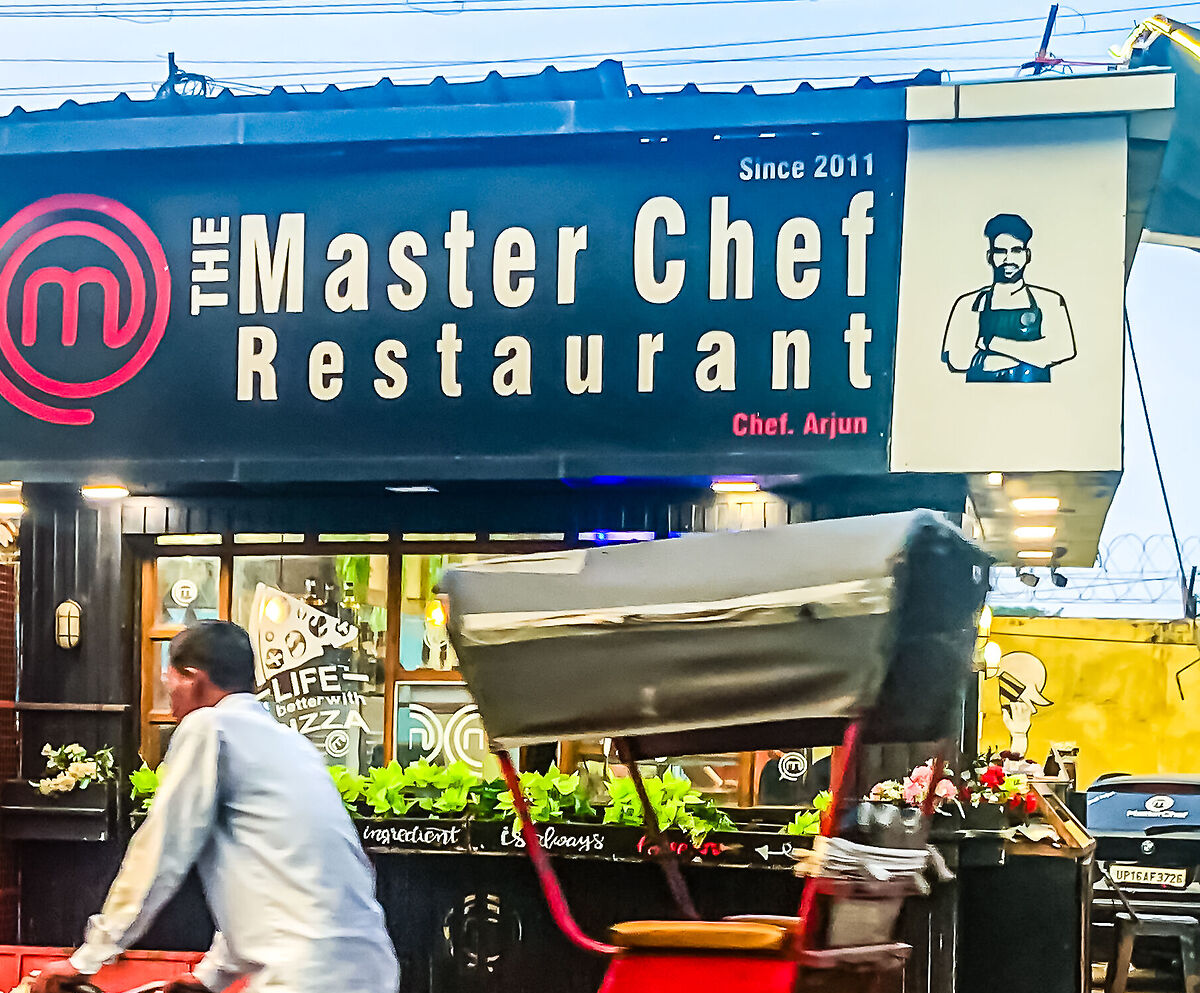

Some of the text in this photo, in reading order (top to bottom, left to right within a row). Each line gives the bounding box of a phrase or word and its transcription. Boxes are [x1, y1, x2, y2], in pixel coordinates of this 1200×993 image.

[739, 153, 873, 181] Since 2011
[190, 190, 874, 316] THE Master Chef
[236, 313, 872, 401] Restaurant
[732, 411, 868, 439] Chef. Arjun
[272, 665, 342, 703] LIFE
[325, 691, 367, 706] with
[287, 709, 371, 735] IZZA
[363, 825, 461, 846] ingredient
[500, 825, 527, 848] is
